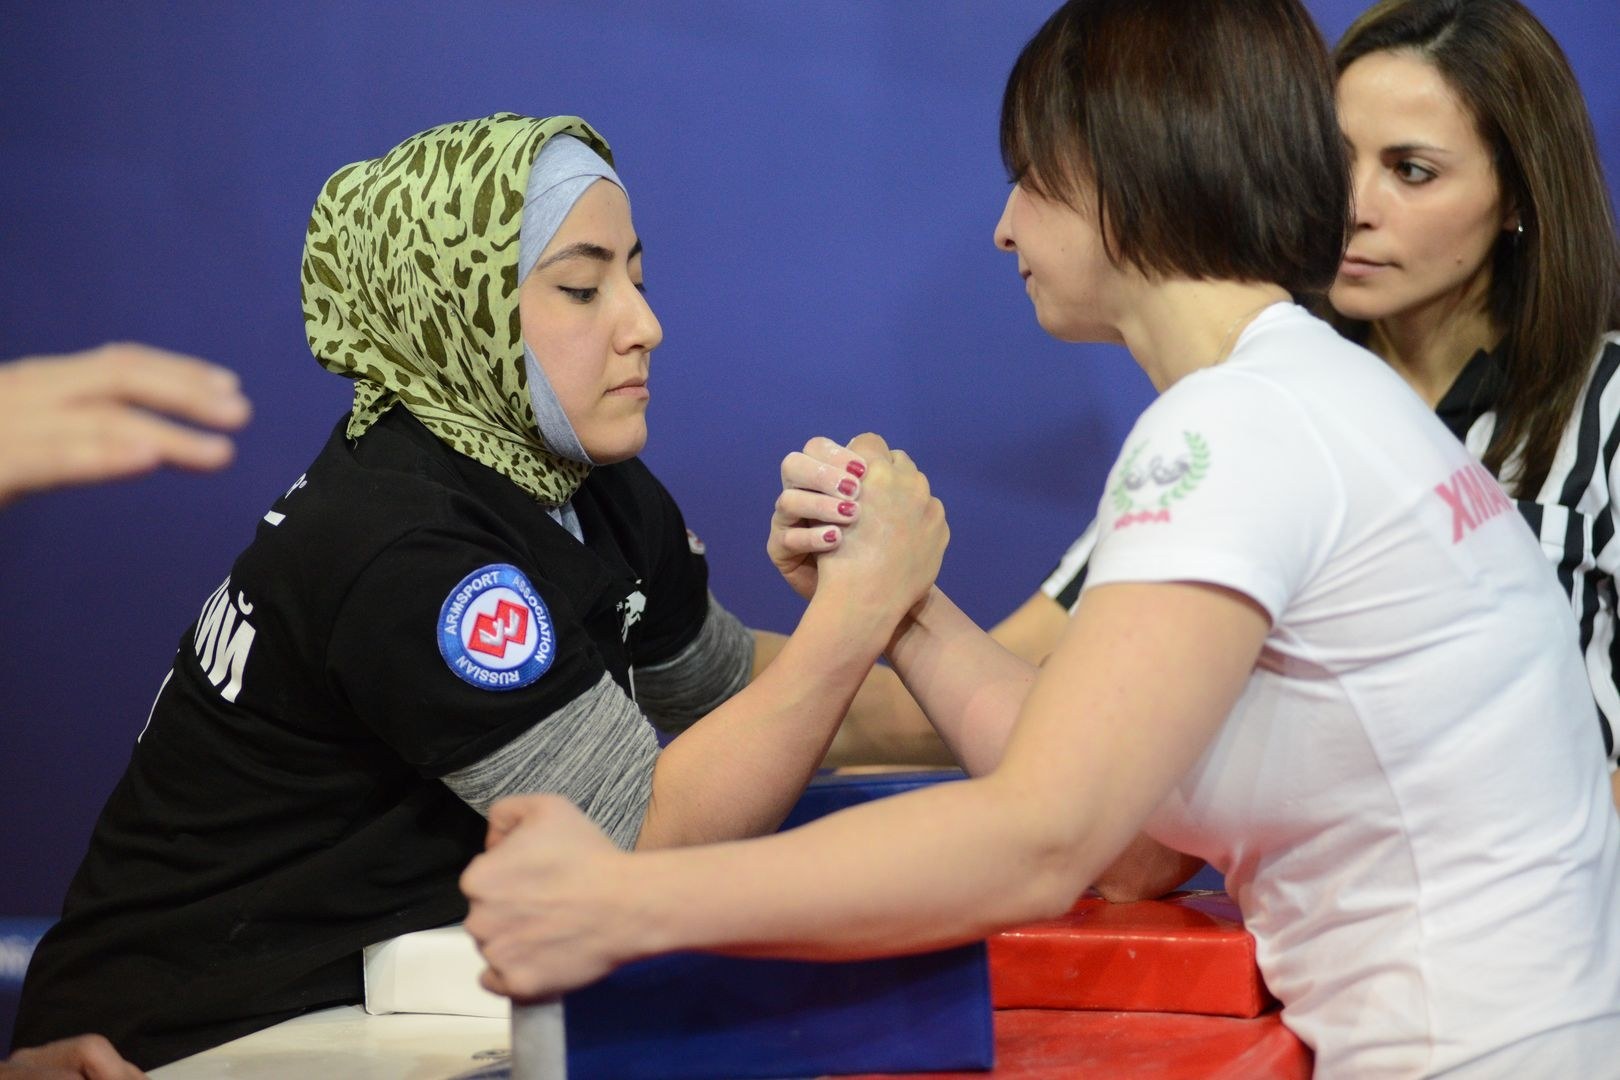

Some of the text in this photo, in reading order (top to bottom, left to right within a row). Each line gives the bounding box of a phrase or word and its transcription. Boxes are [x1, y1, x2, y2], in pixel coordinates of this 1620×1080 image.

[193, 574, 257, 704] ИЙ
[444, 570, 553, 685] RUSSIAN ARMSPORT ASSOCIATION
